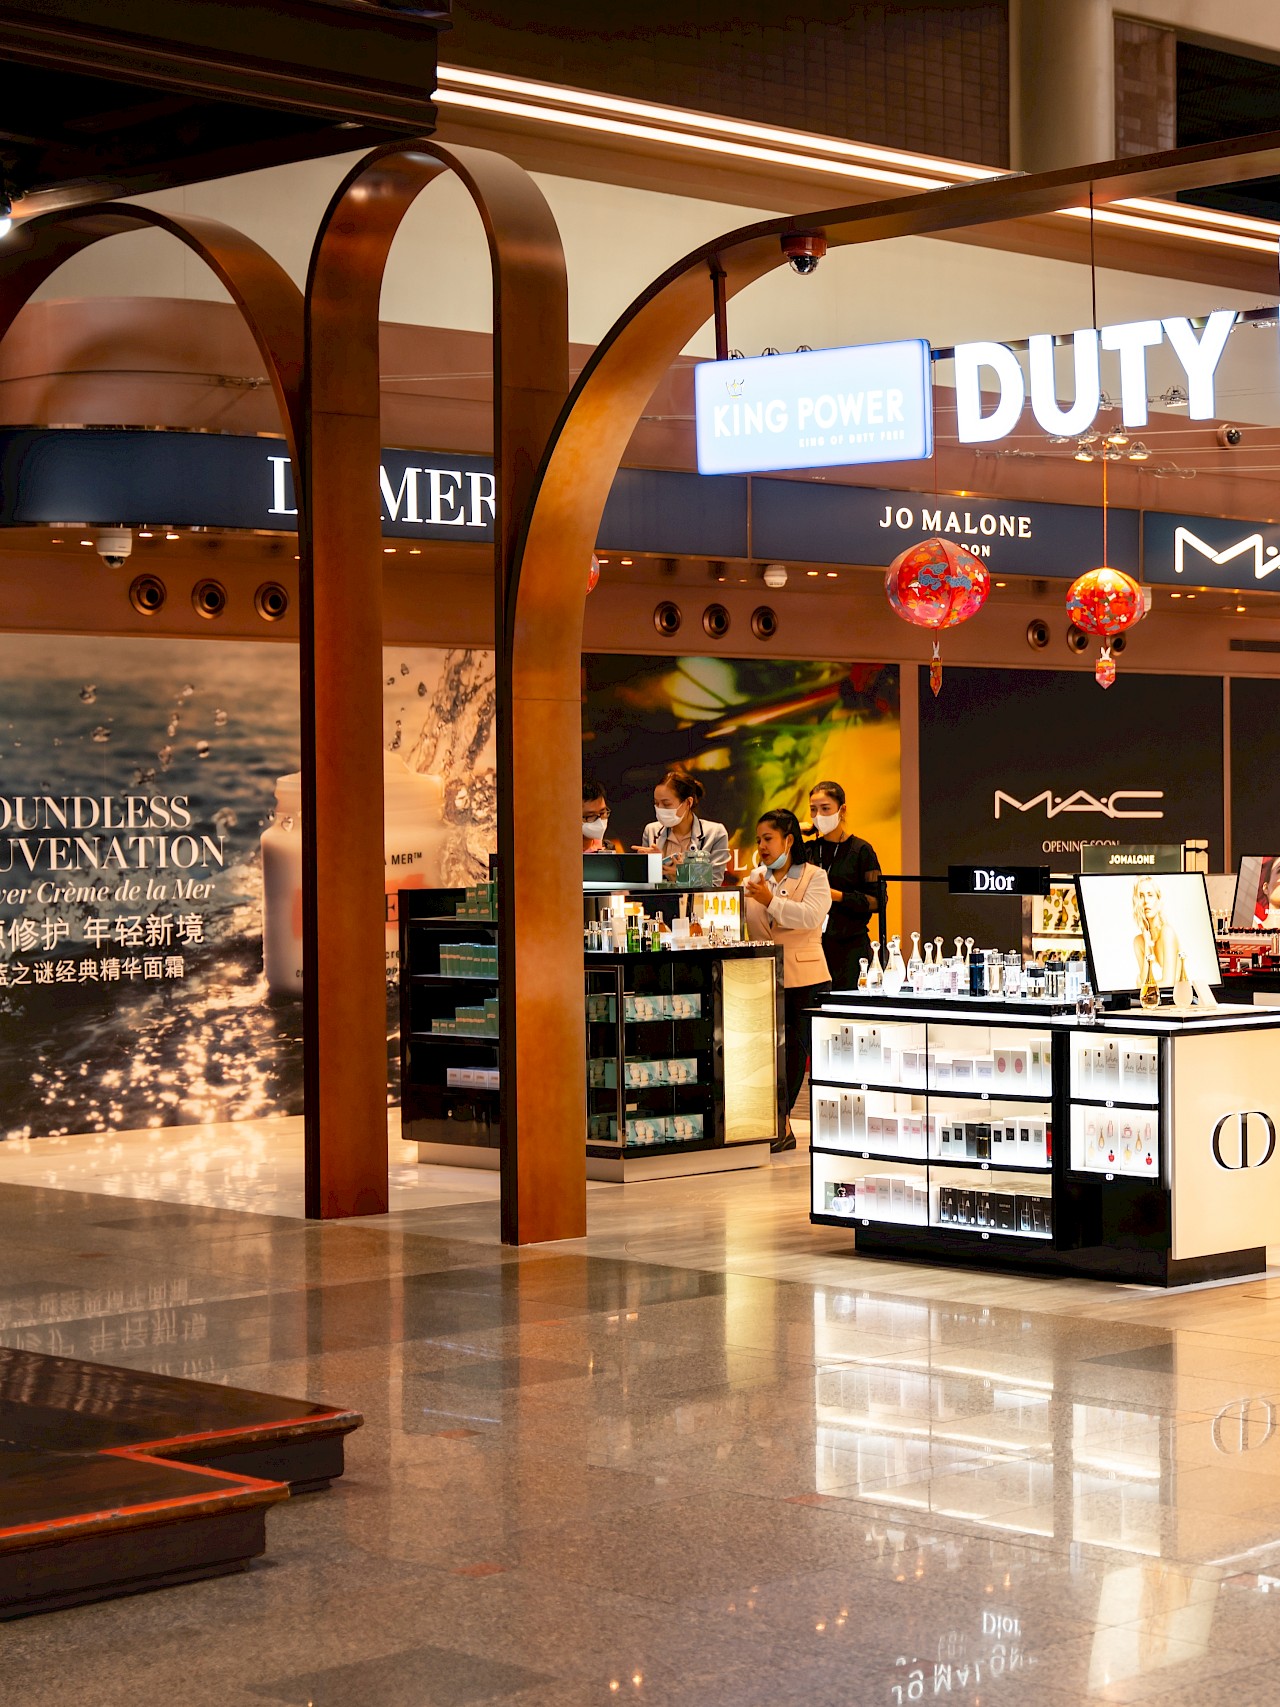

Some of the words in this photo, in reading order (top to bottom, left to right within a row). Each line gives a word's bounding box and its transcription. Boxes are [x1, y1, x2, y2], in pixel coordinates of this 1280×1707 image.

[954, 310, 1237, 443] DUTY
[714, 399, 788, 437] KING
[798, 388, 904, 430] POWER
[267, 455, 299, 515] L
[380, 465, 496, 526] MER
[879, 506, 914, 529] JO
[921, 508, 1032, 538] MALONE
[0, 795, 191, 830] UNDLESS
[37, 881, 109, 904] Crème
[115, 879, 141, 902] de
[146, 878, 167, 901] la
[172, 878, 215, 900] Mer
[974, 869, 1015, 891] Dior
[0, 917, 70, 953] 修护
[83, 912, 205, 950] 年轻新境
